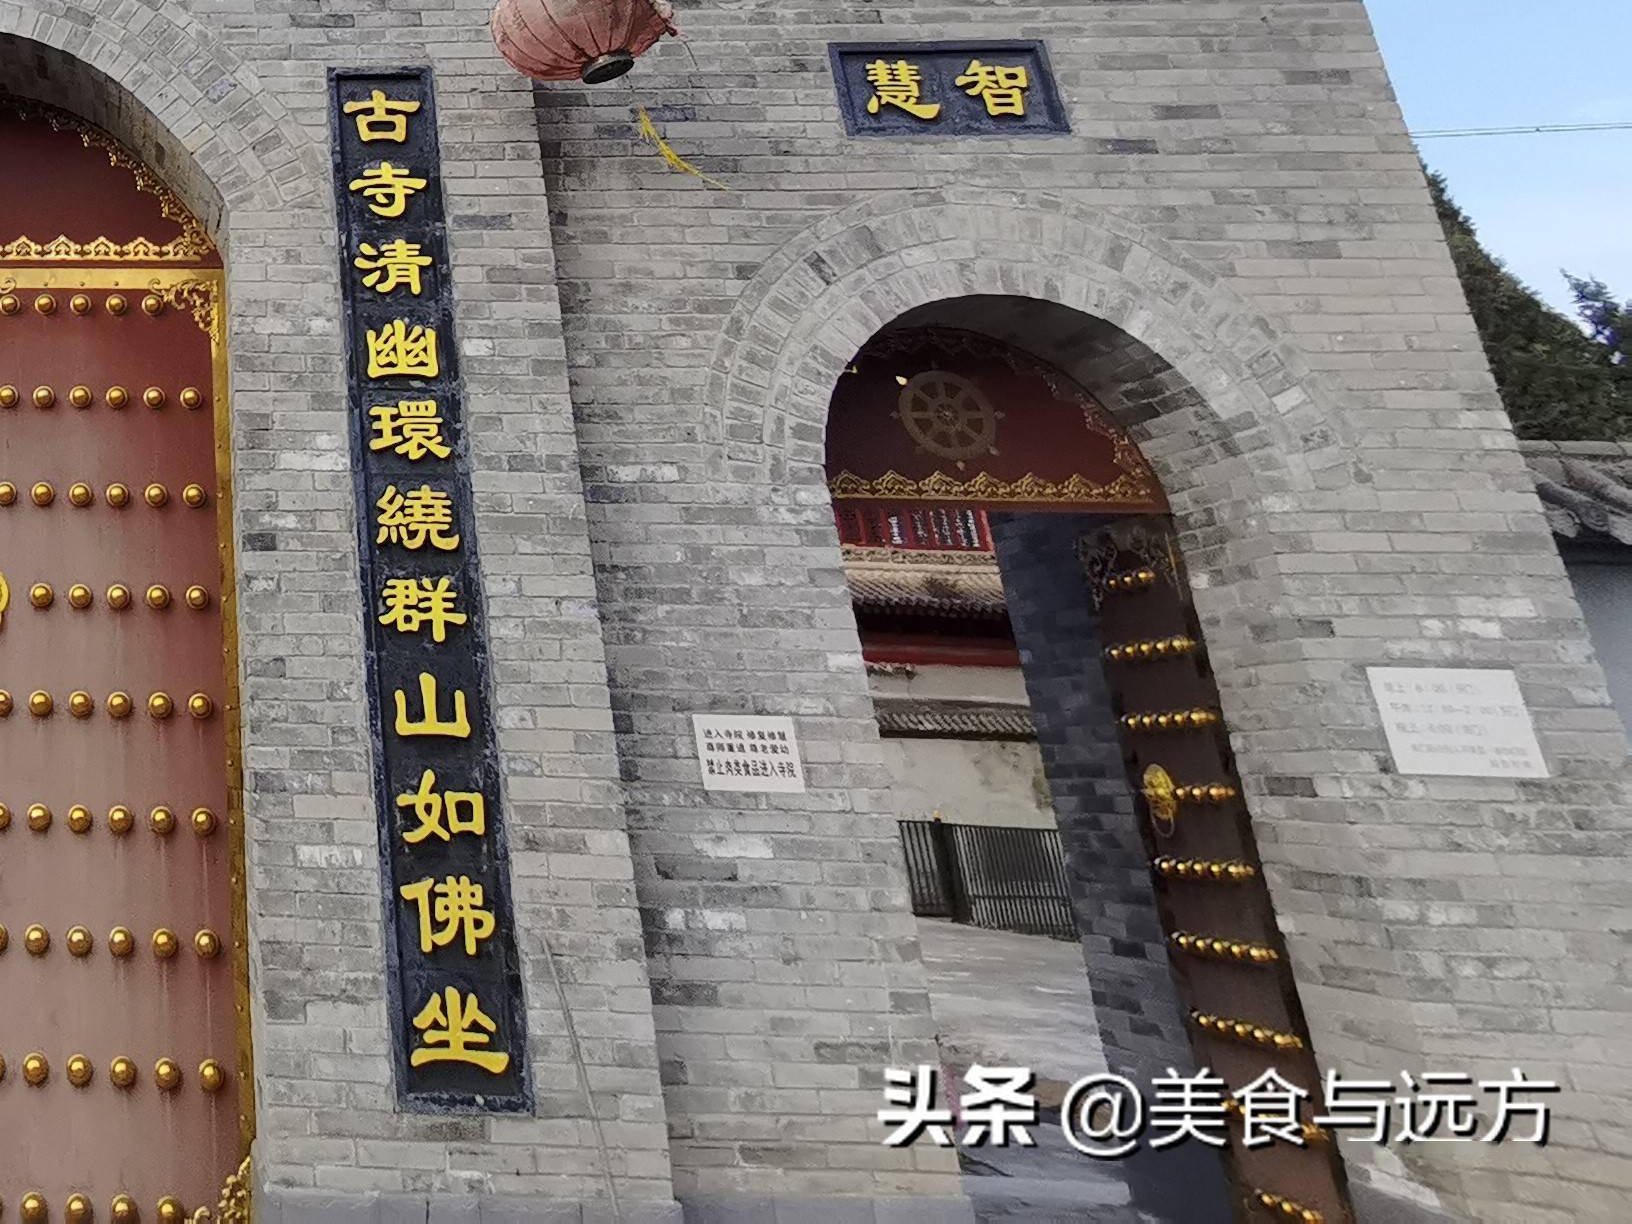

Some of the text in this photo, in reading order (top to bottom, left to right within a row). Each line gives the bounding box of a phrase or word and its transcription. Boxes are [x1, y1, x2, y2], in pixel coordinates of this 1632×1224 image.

[865, 59, 1029, 119] 智慧
[343, 90, 509, 1074] 古寺清幽環繞群山如佛坐
